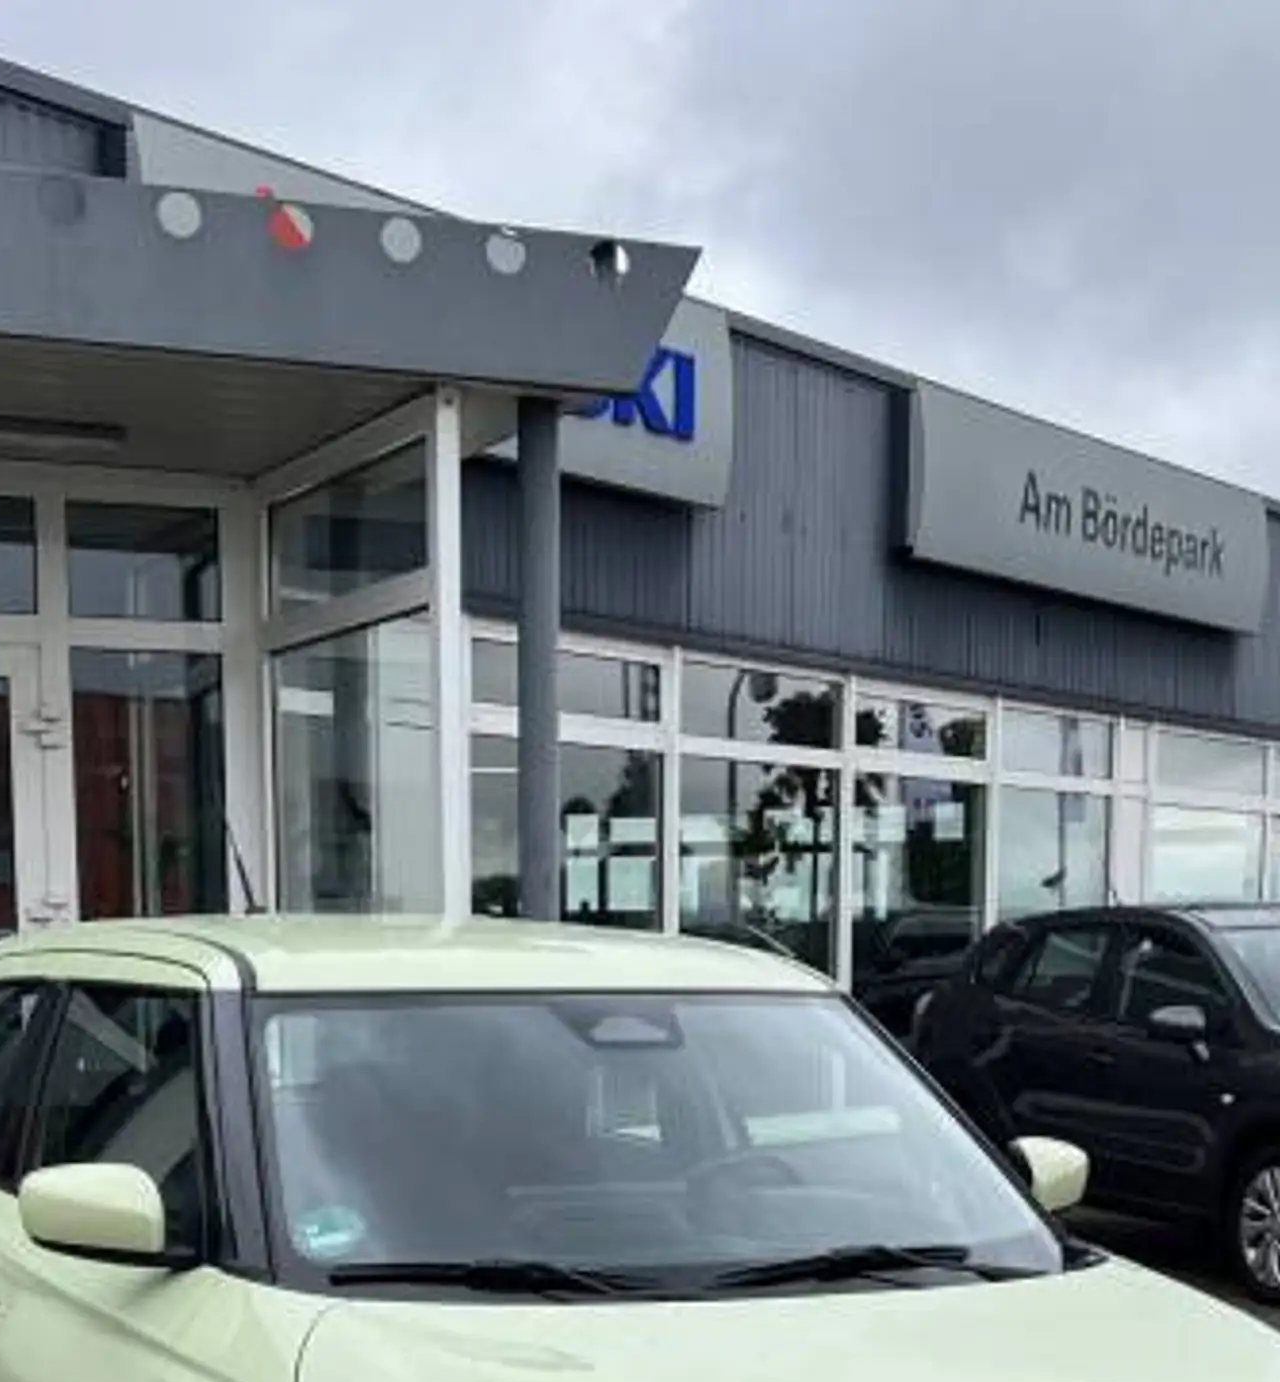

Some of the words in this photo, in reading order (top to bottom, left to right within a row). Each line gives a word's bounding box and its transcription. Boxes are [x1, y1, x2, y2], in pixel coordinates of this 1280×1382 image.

[584, 346, 695, 442] KI
[1019, 469, 1071, 536] Am
[1081, 486, 1225, 577] Bördepark
